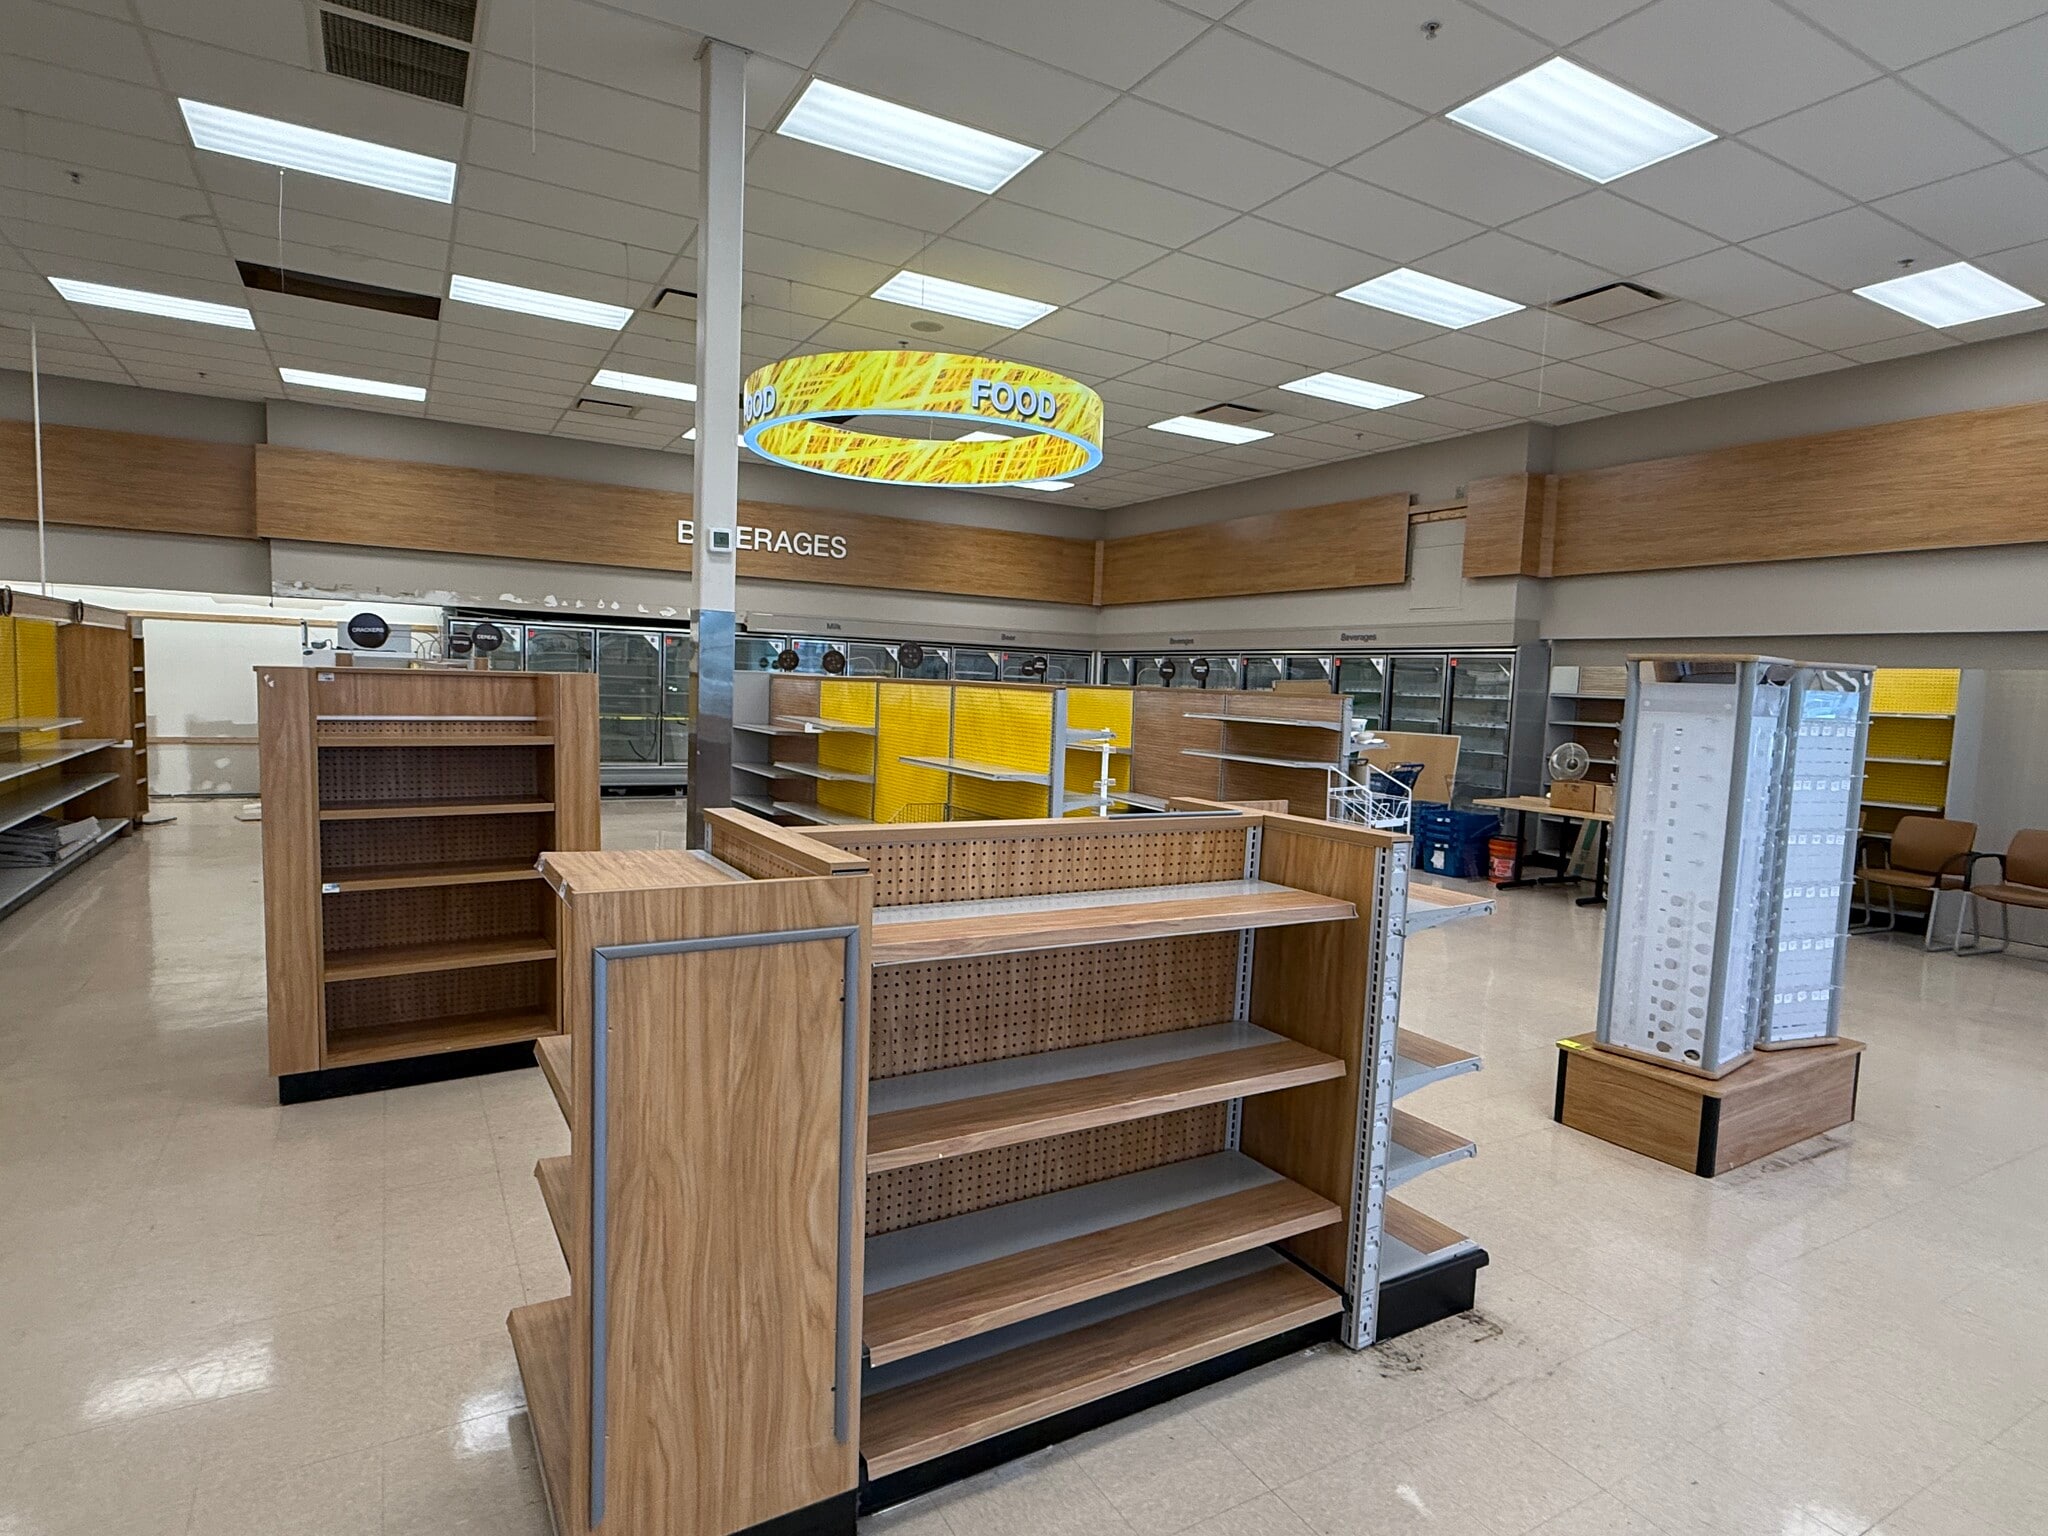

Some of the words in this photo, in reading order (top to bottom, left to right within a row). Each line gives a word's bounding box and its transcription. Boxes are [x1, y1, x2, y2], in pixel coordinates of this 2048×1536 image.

[744, 384, 776, 422] OOD
[971, 379, 1057, 421] FOOD
[676, 519, 848, 560] BERAGES
[351, 626, 385, 634] CRACKERS
[476, 633, 499, 641] CEREAL
[1340, 632, 1377, 643] Beverages
